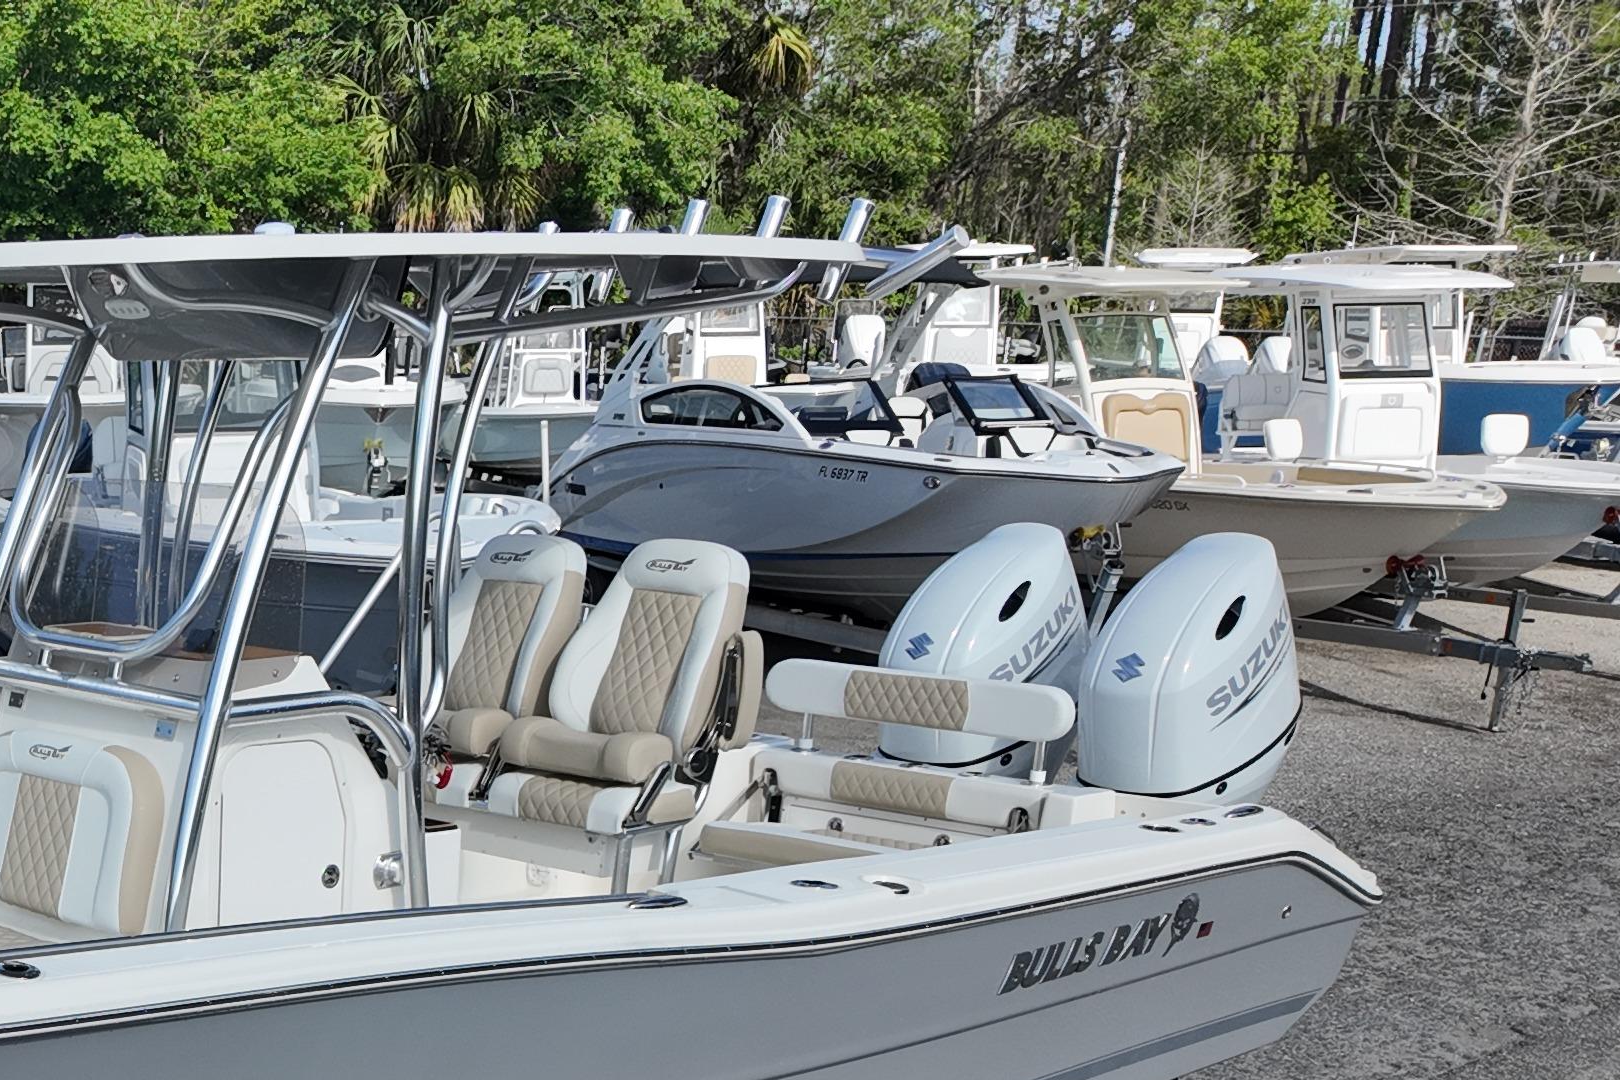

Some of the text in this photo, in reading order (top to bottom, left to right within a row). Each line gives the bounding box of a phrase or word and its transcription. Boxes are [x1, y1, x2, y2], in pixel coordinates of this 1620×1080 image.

[819, 466, 827, 477] FL
[856, 470, 868, 482] TR
[988, 584, 1077, 682] SUZUKI
[1206, 600, 1289, 716] SUZUKI
[996, 912, 1172, 996] BULLS BAY
